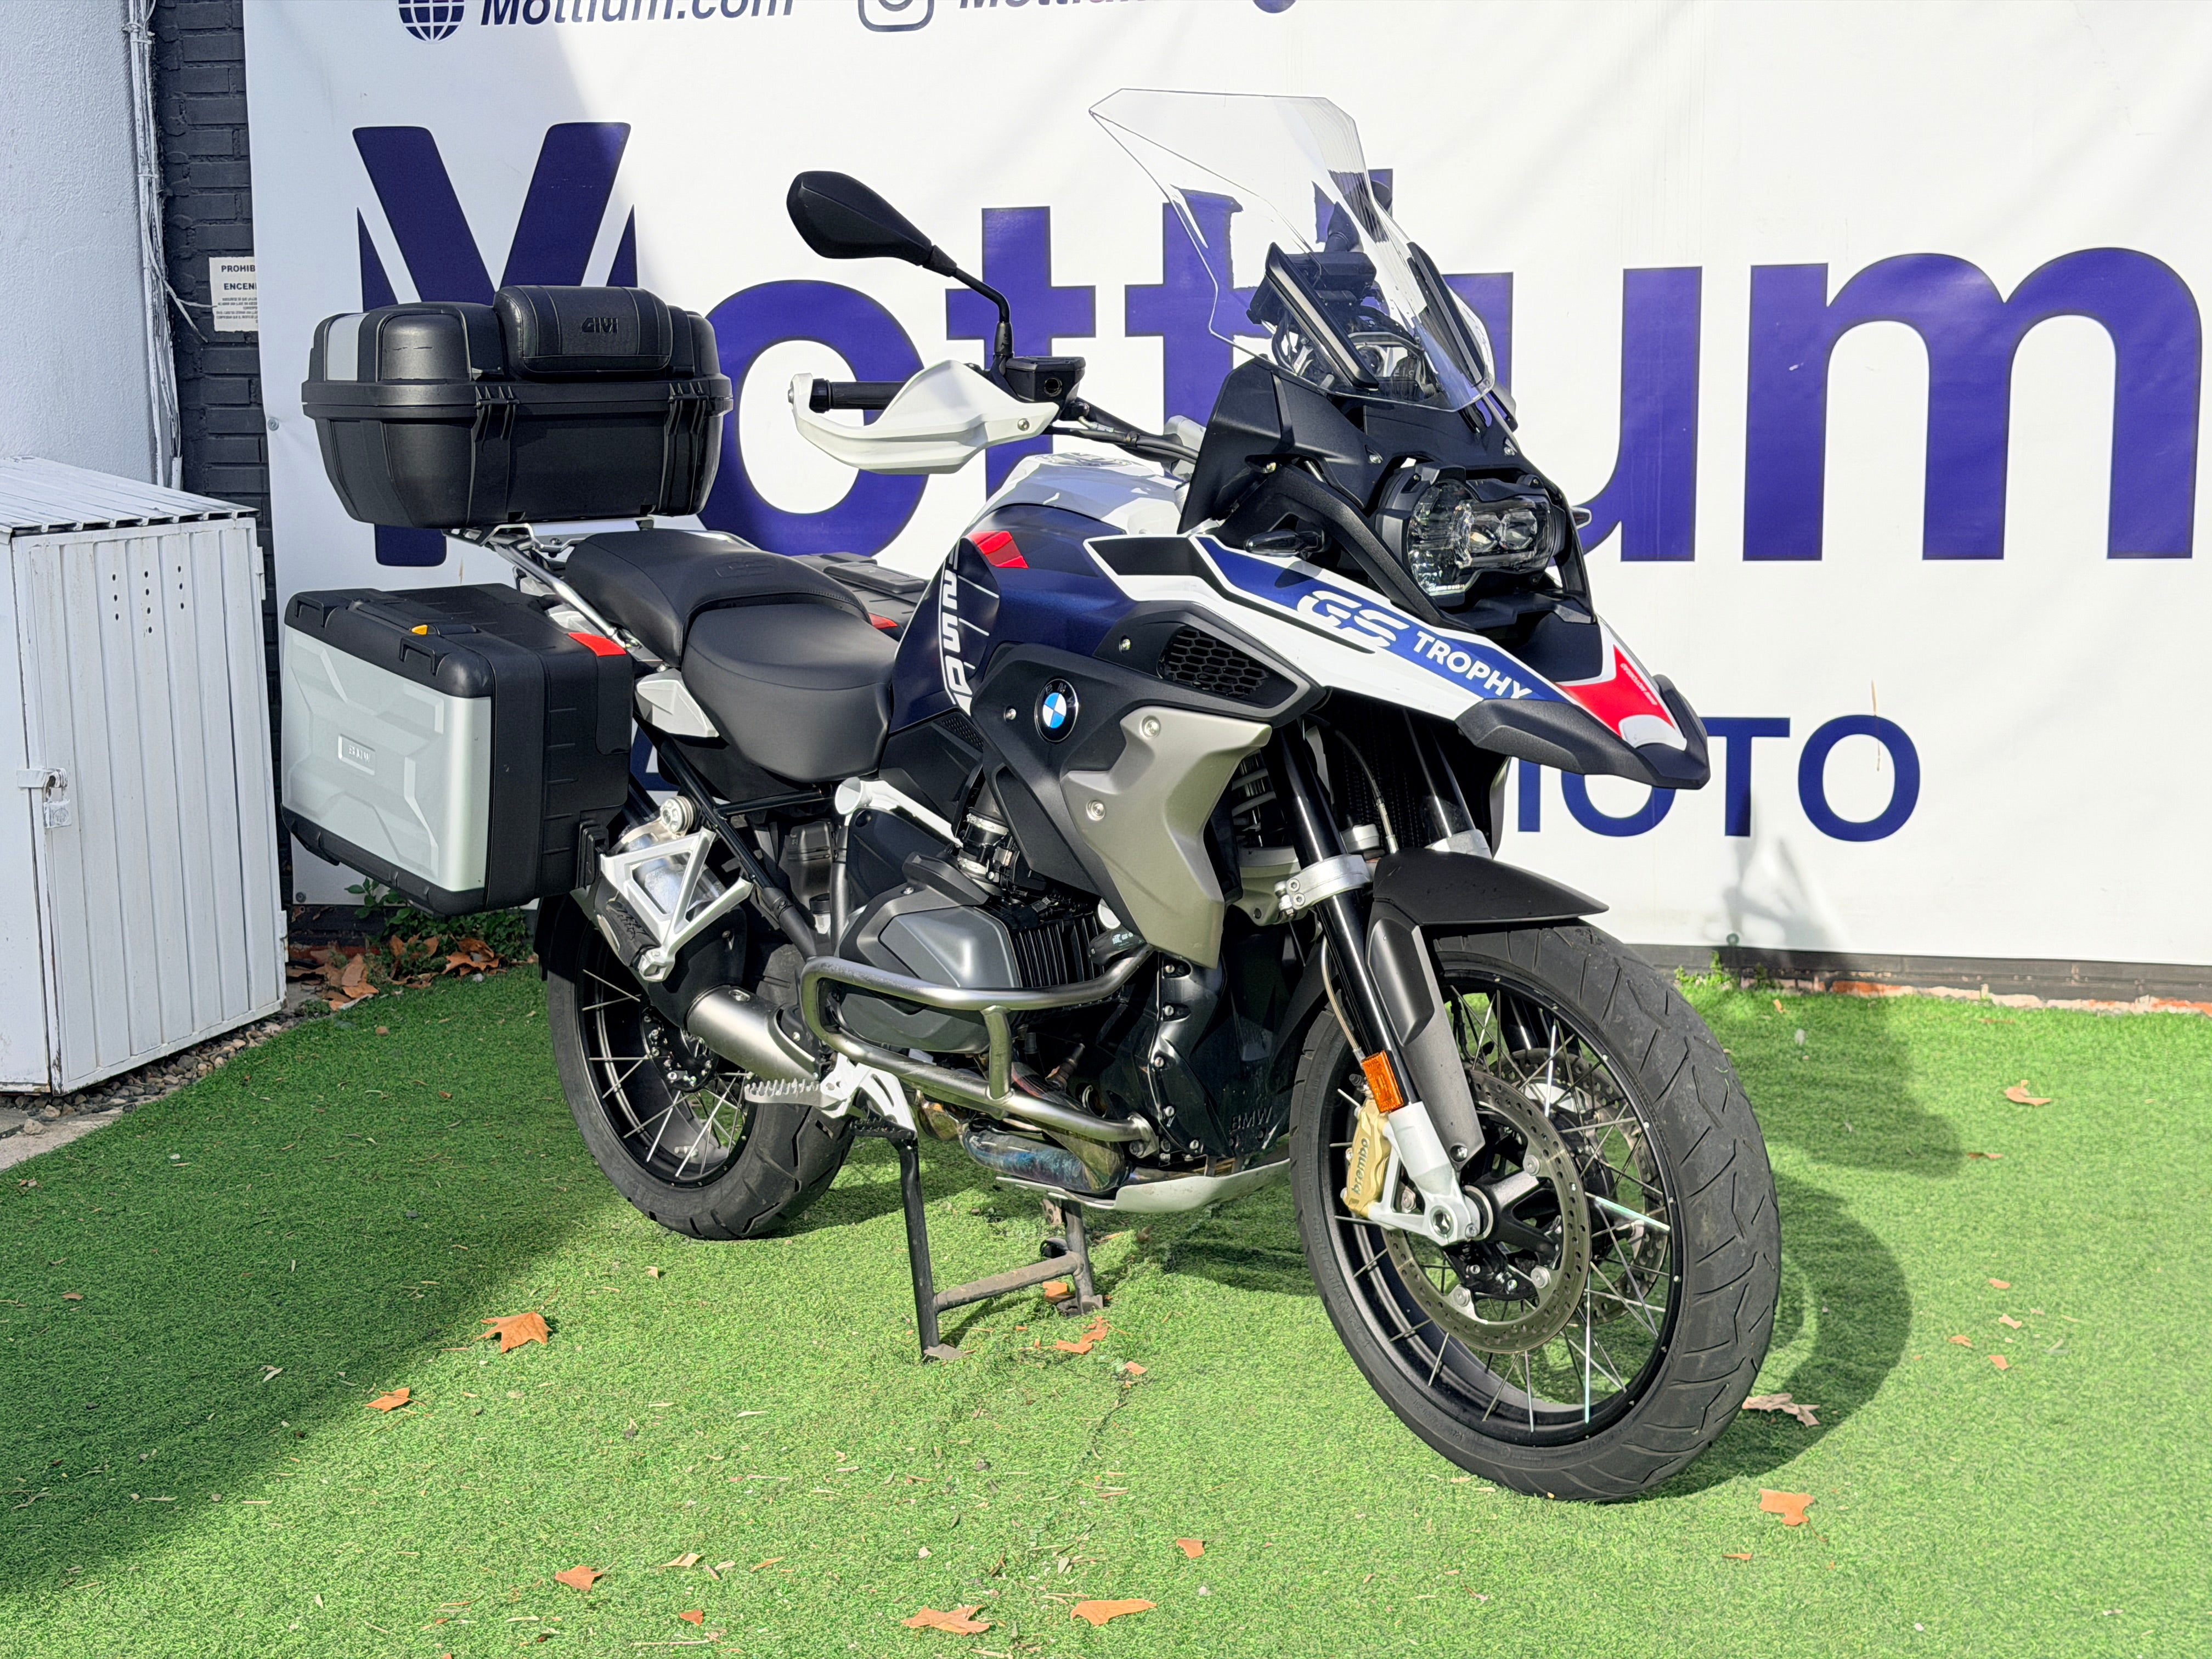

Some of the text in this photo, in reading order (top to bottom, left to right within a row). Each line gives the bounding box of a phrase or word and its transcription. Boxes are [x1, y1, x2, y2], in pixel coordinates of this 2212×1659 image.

[224, 283, 257, 291] ENCEN
[582, 317, 618, 334] GIVI
[353, 122, 2202, 567] ottum
[1296, 590, 1533, 699] GS TROPHY
[1518, 714, 1921, 842] OTO
[1351, 1137, 1369, 1195] brembo
